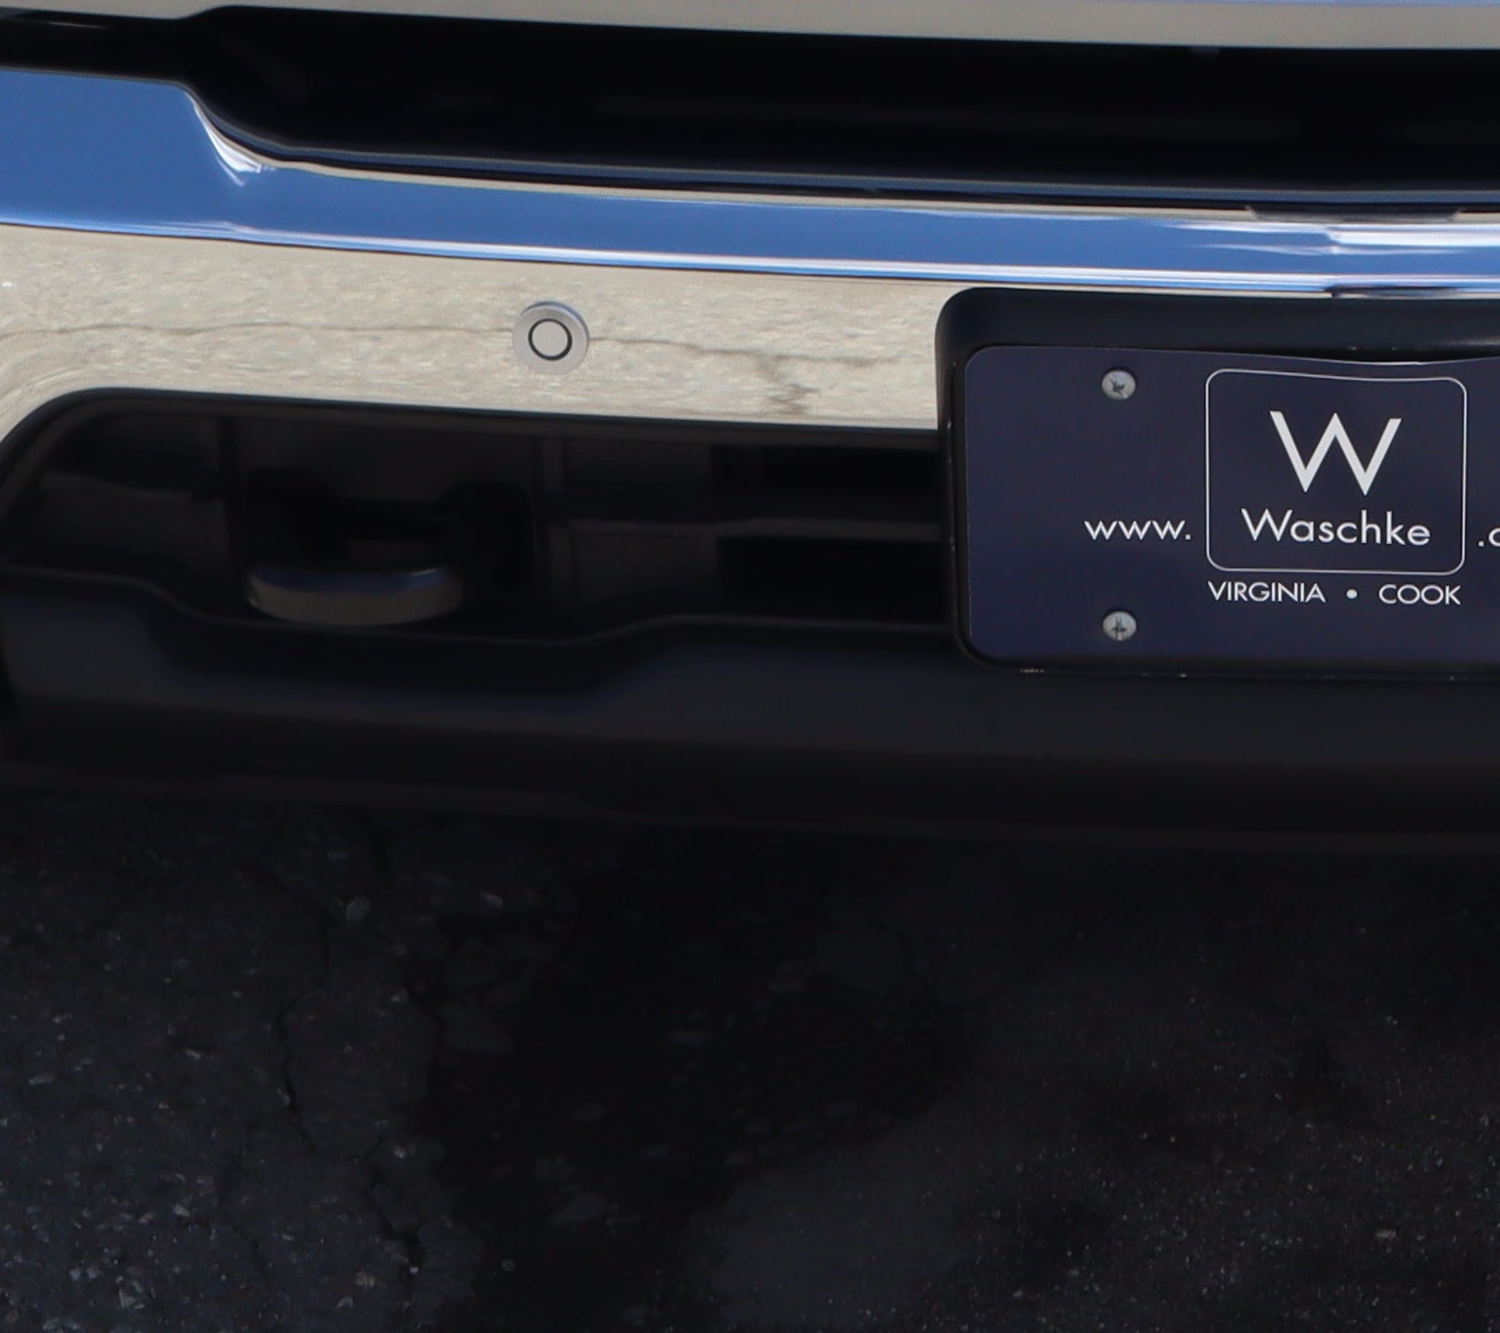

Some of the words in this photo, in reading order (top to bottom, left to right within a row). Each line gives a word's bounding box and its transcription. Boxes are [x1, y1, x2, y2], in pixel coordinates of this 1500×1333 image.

[1269, 410, 1402, 496] W
[1083, 519, 1192, 541] www.
[1241, 507, 1431, 546] Waschke
[1207, 580, 1327, 603] VIRGINIA
[1378, 583, 1461, 606] COOK
